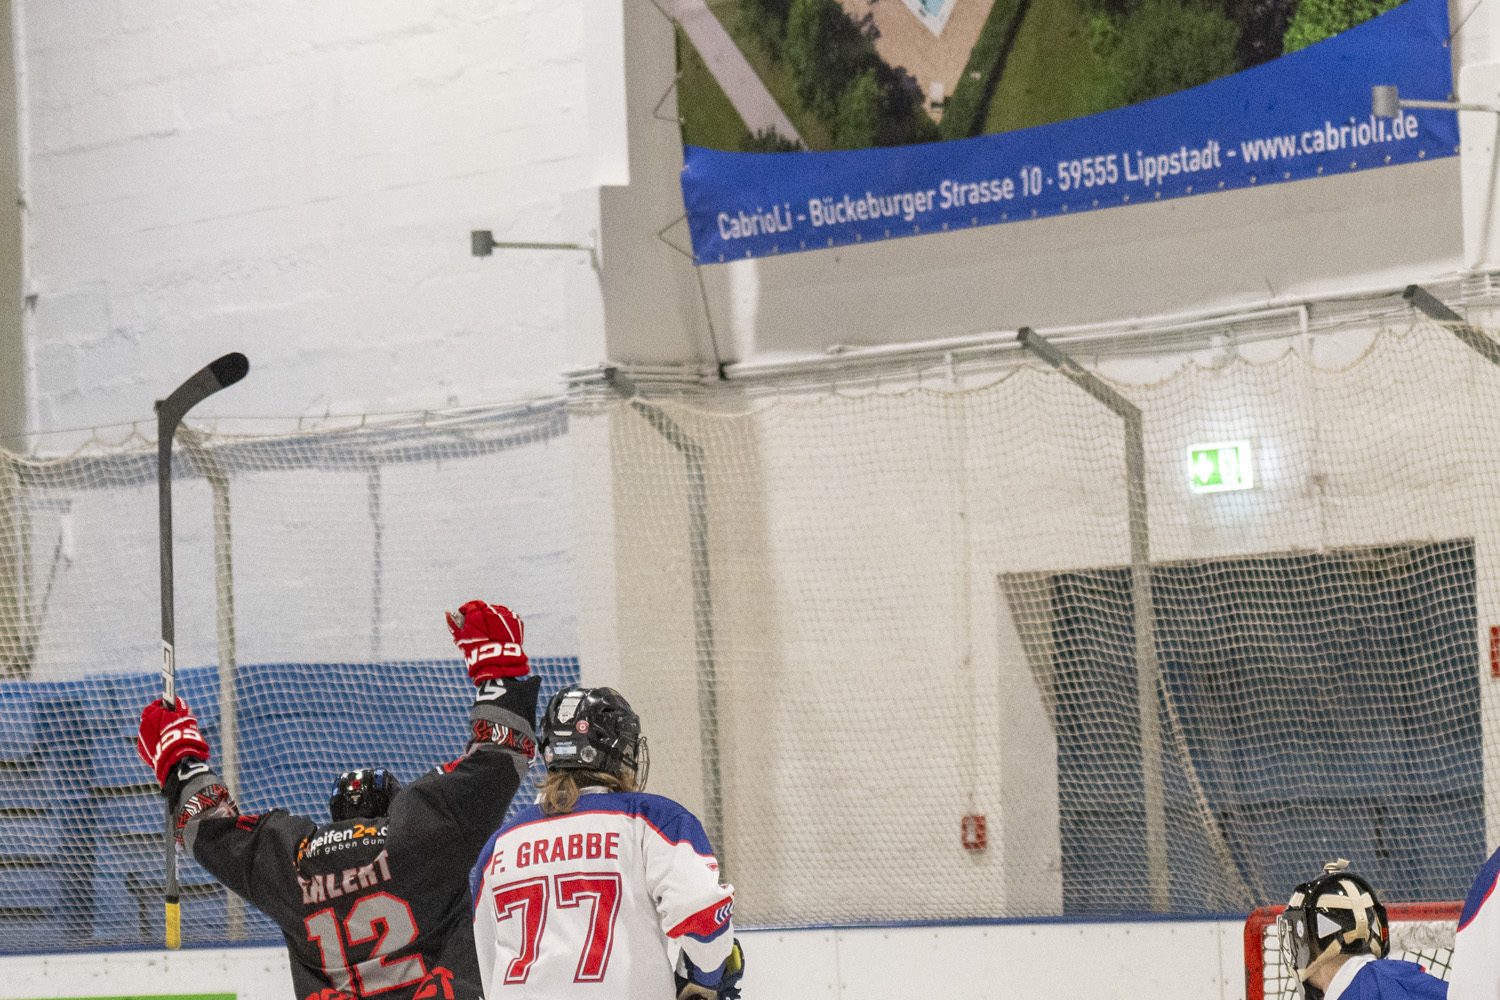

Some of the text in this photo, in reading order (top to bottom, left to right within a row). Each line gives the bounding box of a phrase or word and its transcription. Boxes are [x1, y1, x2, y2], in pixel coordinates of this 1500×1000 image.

[717, 203, 793, 240] CabrioLi
[808, 188, 937, 226] Bückeburger
[940, 177, 1015, 208] Strasse
[1020, 166, 1042, 195] 10
[1056, 154, 1118, 191] 59555
[1123, 140, 1222, 186] Lippstadt
[1241, 110, 1419, 164] www.cabrioli.de
[324, 841, 358, 855] geben
[362, 837, 385, 846] Gum
[490, 832, 620, 876] F. GRABBE
[303, 890, 427, 998] 12
[492, 872, 622, 985] 77
